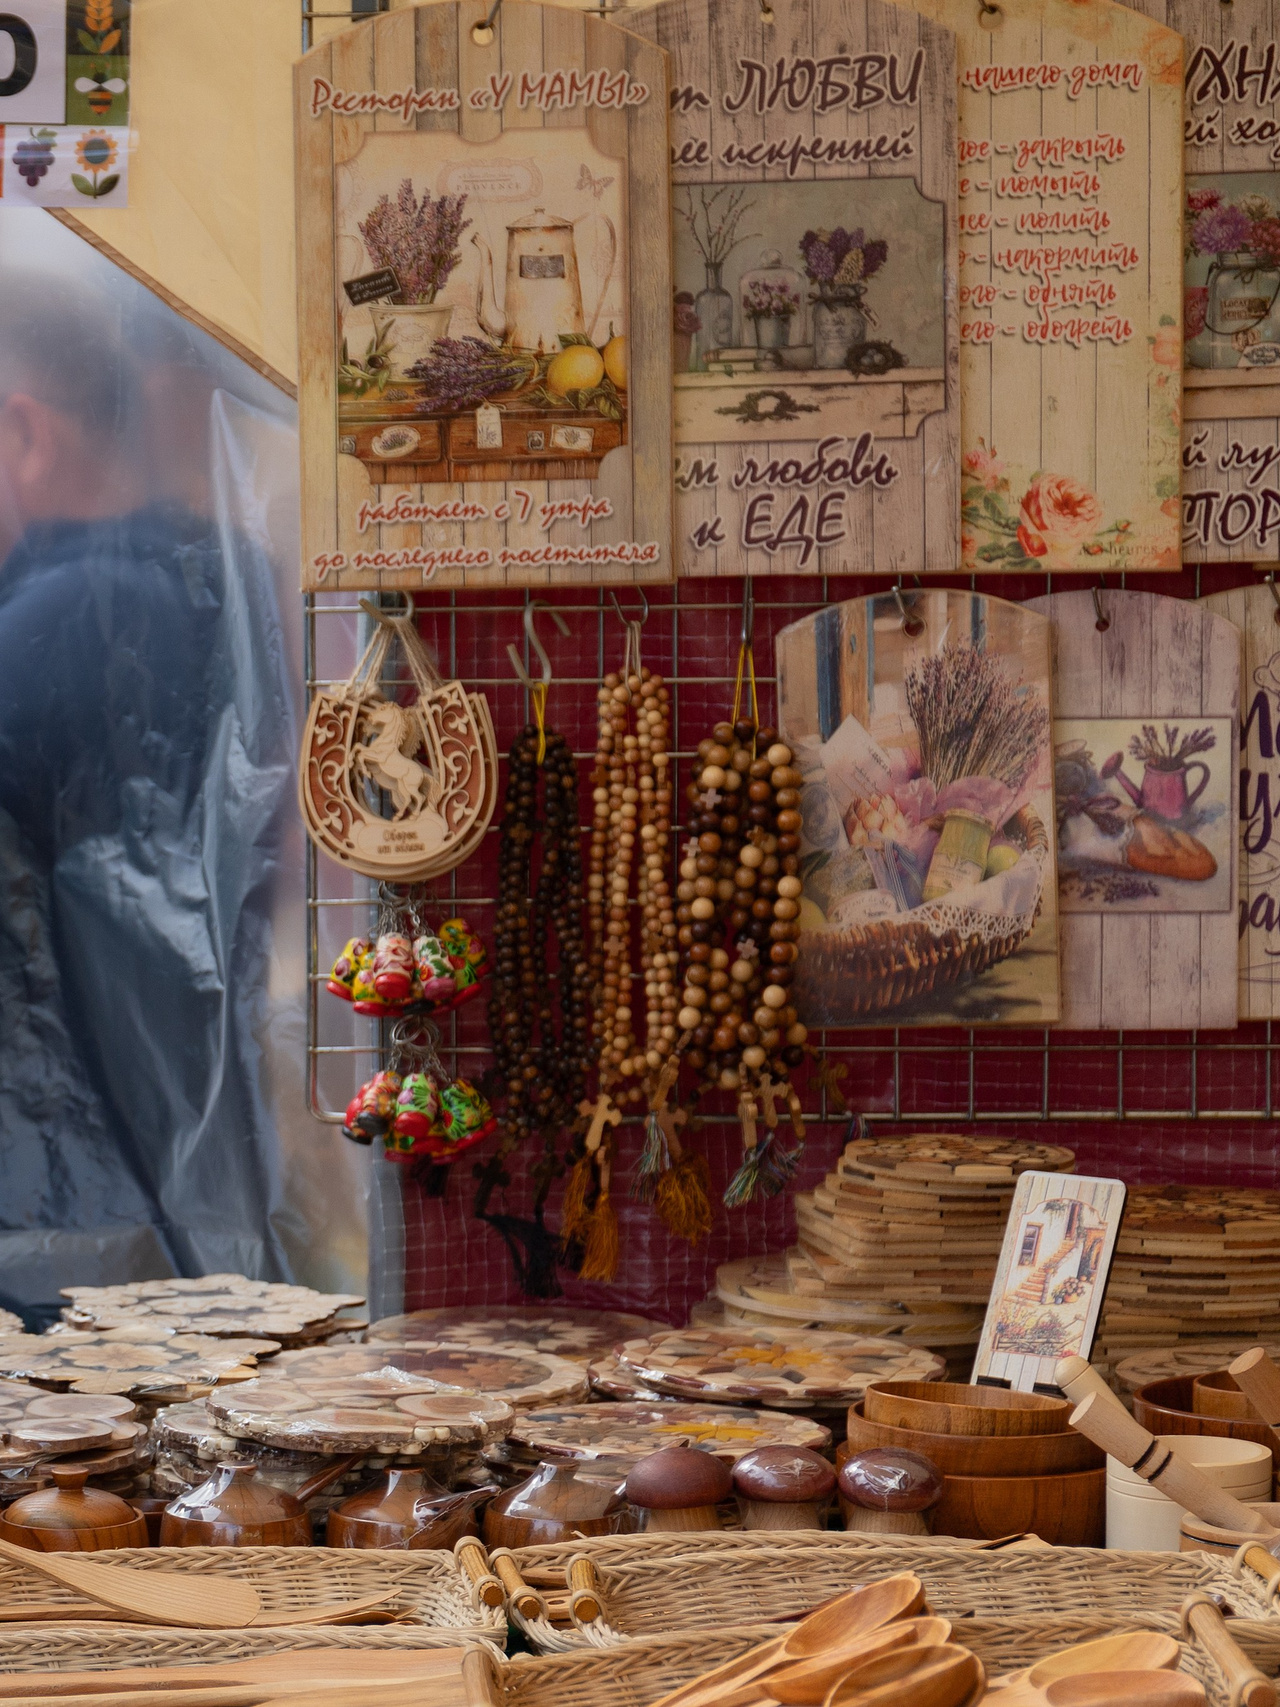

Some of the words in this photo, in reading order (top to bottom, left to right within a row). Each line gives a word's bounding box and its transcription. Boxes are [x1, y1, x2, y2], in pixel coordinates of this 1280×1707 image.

[312, 78, 458, 120] Ресторан
[470, 74, 510, 108] «У
[520, 70, 648, 108] МАМЫ»
[725, 50, 924, 112] ЛЮБВИ
[966, 64, 1063, 89] нашего
[1071, 63, 1143, 96] дома
[722, 125, 916, 177] искренней
[1017, 133, 1126, 168] закрыть
[1001, 170, 1101, 195] помыть
[1020, 207, 1111, 231] полить
[997, 242, 1140, 271] накормить
[1029, 267, 1117, 303] обнять
[1027, 303, 1133, 344] обогреть
[734, 432, 899, 487] любовь
[359, 494, 486, 531] работает
[495, 502, 509, 519] с
[515, 490, 531, 520] 7
[540, 497, 610, 528] утра
[693, 517, 726, 547] к
[745, 491, 846, 566] ЕДЕ
[314, 552, 345, 579] до
[355, 548, 489, 576] последнего
[499, 543, 657, 565] посетителя
